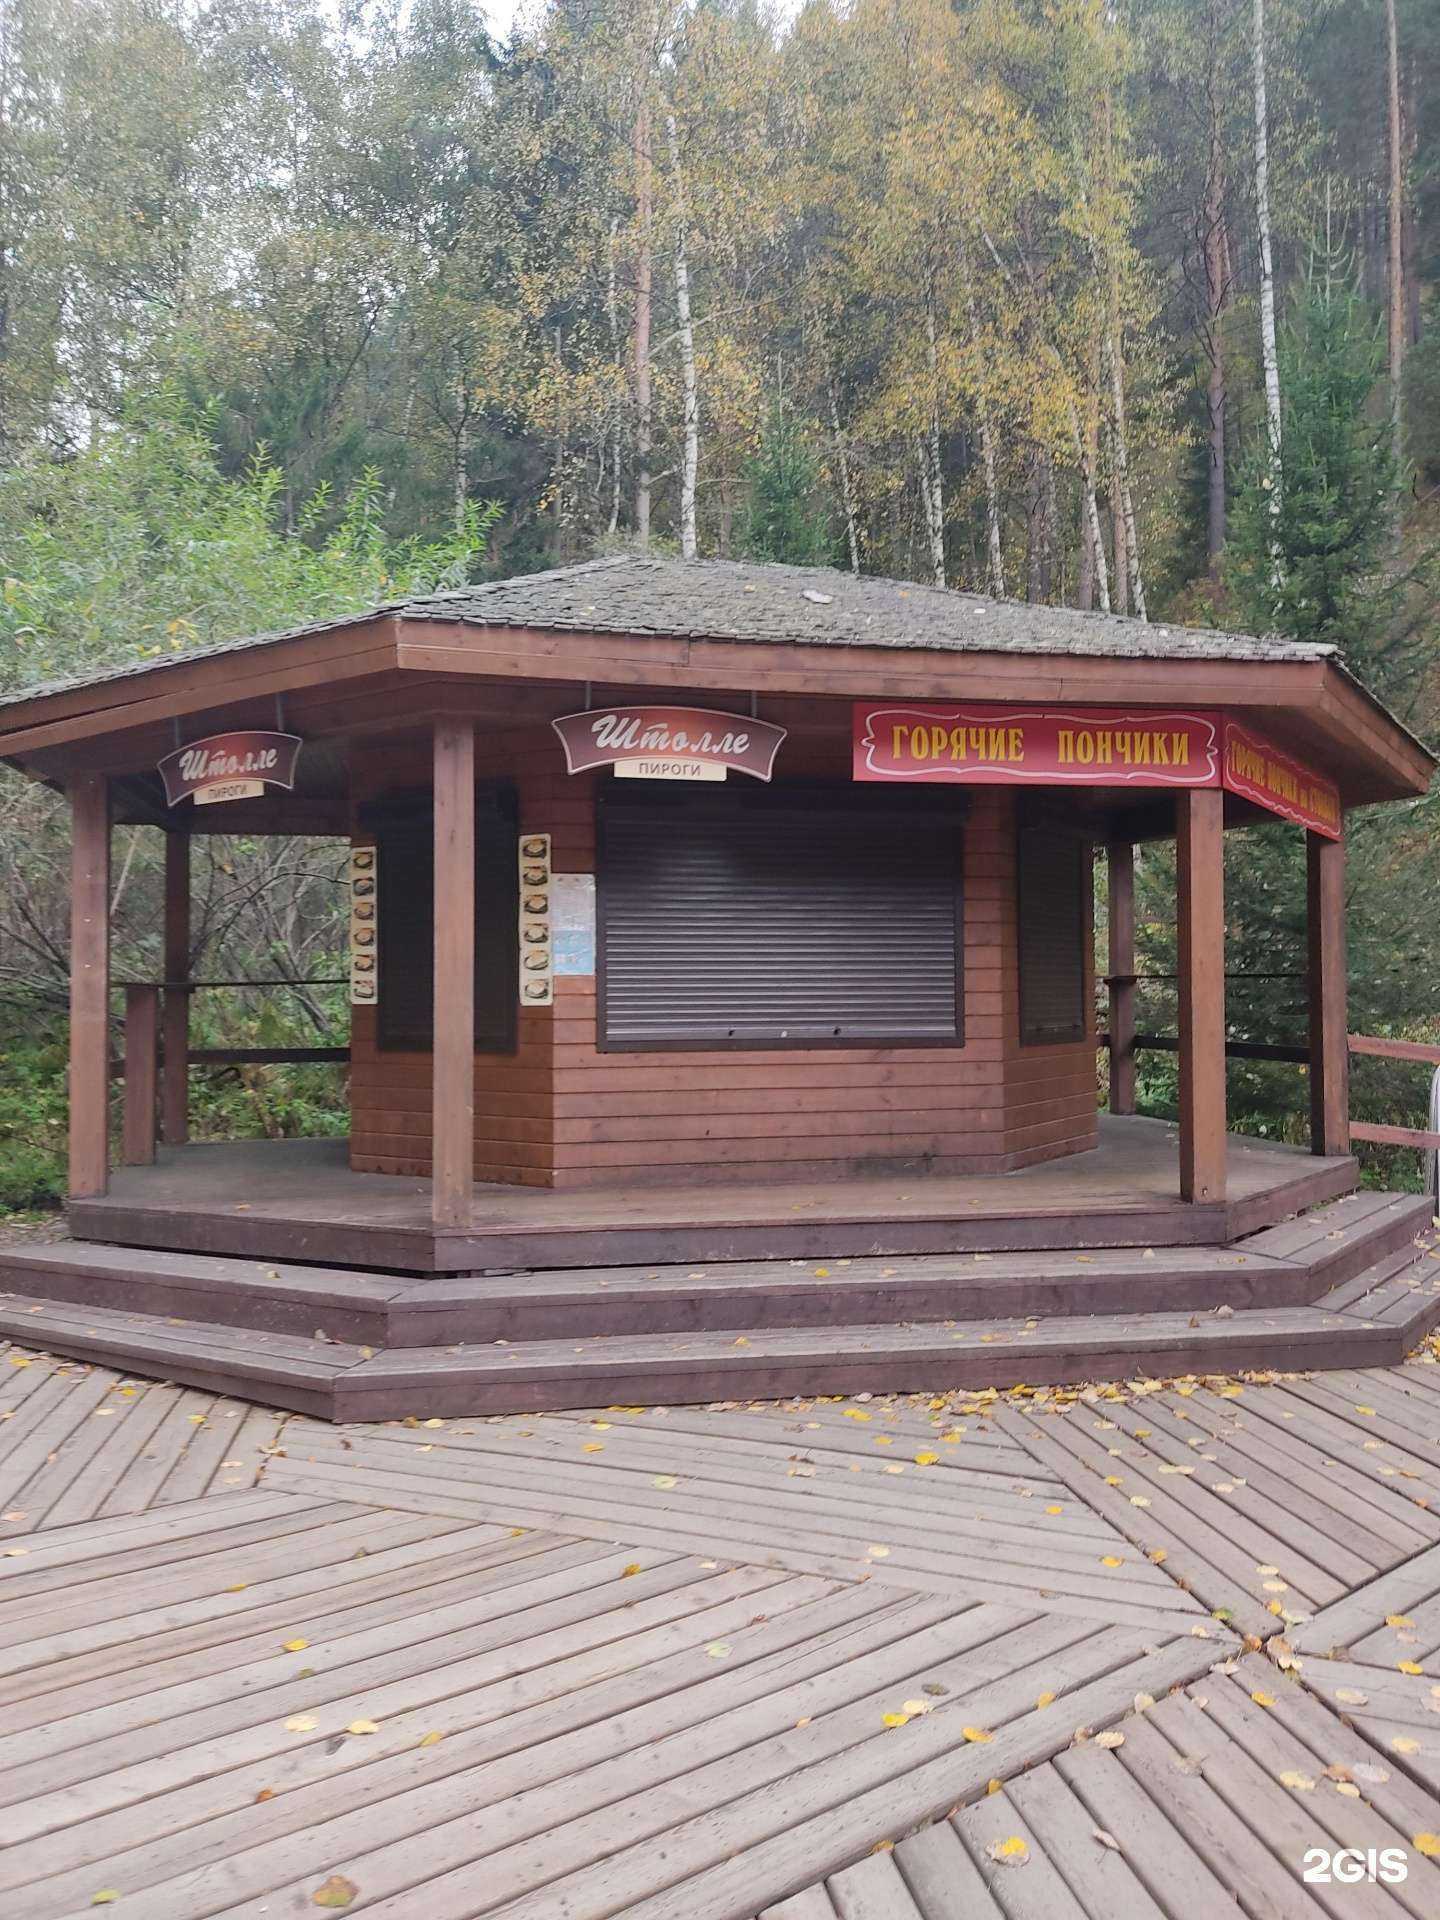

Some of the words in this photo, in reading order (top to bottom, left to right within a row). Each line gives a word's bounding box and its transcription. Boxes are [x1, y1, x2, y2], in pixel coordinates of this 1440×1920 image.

[591, 715, 750, 754] Штолле
[892, 724, 1025, 762] ГОРЯЧИЕ
[1057, 729, 1190, 766] ПОНЧИКИ
[178, 748, 278, 781] Штолле
[638, 762, 702, 777] ПИРОГИ
[207, 783, 249, 800] ПИРОГИ
